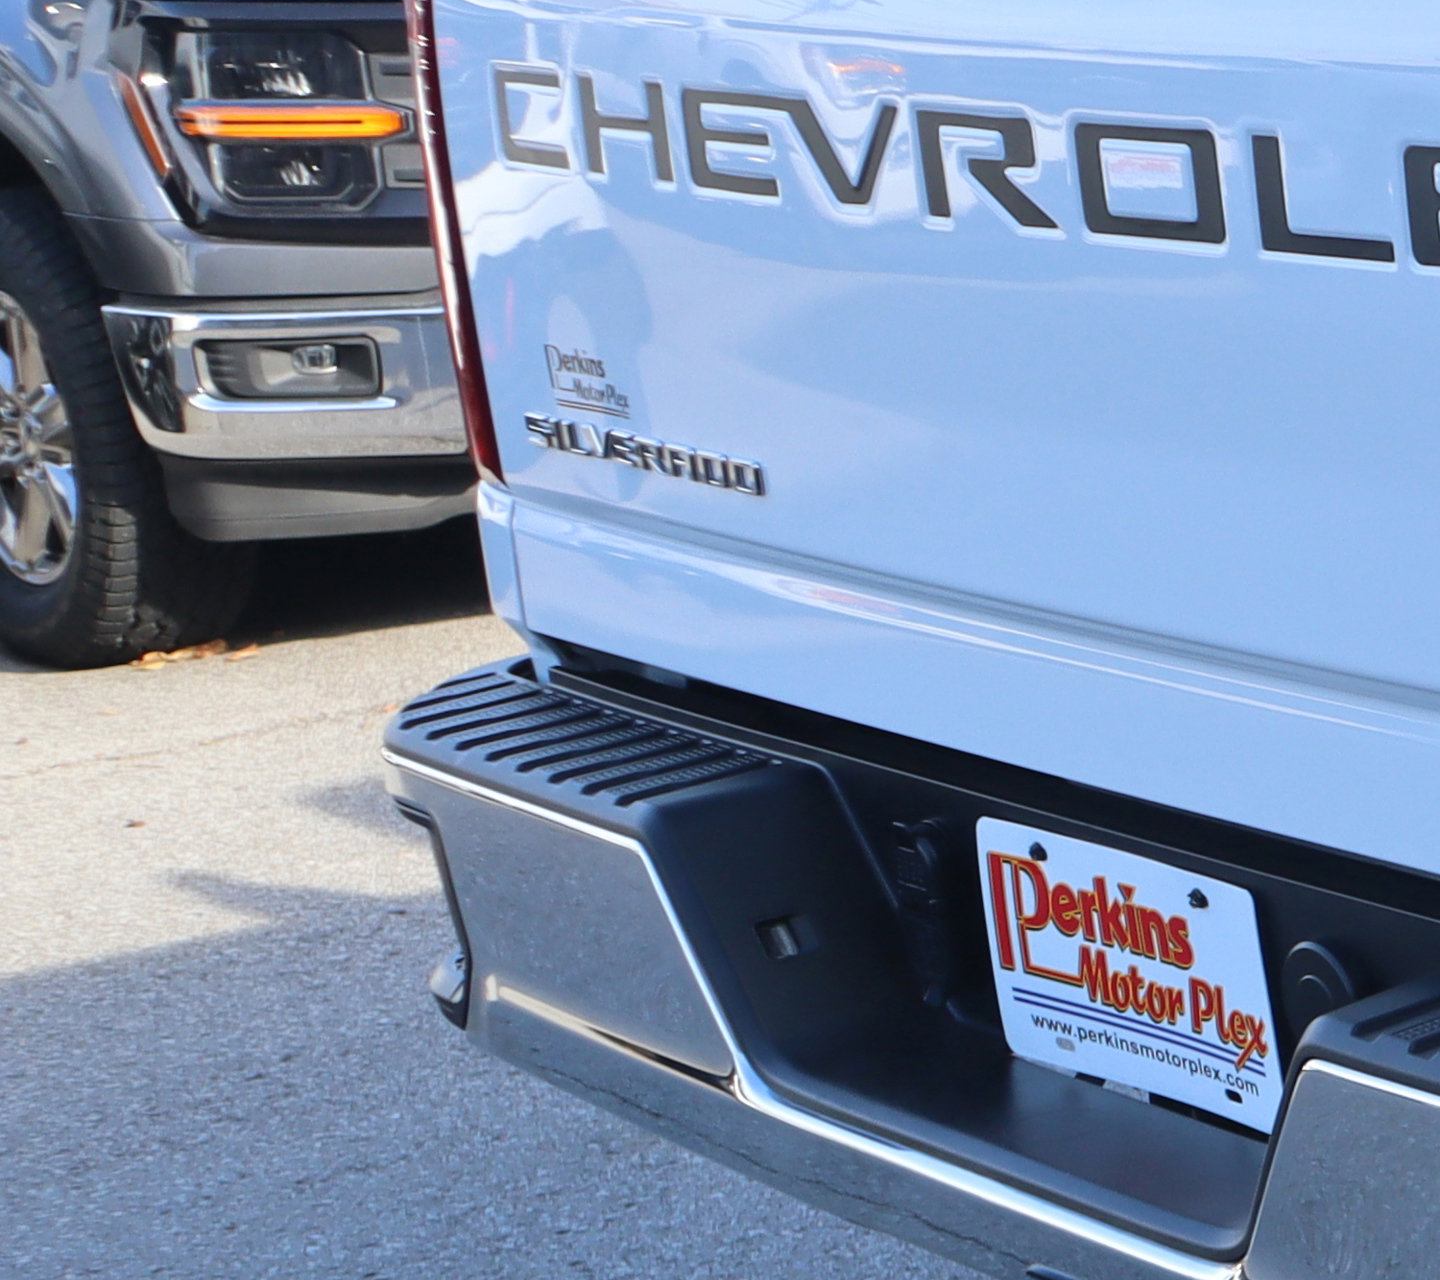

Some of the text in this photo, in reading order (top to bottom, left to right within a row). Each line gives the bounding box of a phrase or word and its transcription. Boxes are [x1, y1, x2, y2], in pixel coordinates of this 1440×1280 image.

[543, 343, 606, 389] Perkins
[523, 411, 766, 496] SILVERADO
[987, 850, 1195, 969] Perkins
[1077, 944, 1270, 1070] Motor Plex
[1031, 1013, 1260, 1097] www.perkinsmotorplex.com
